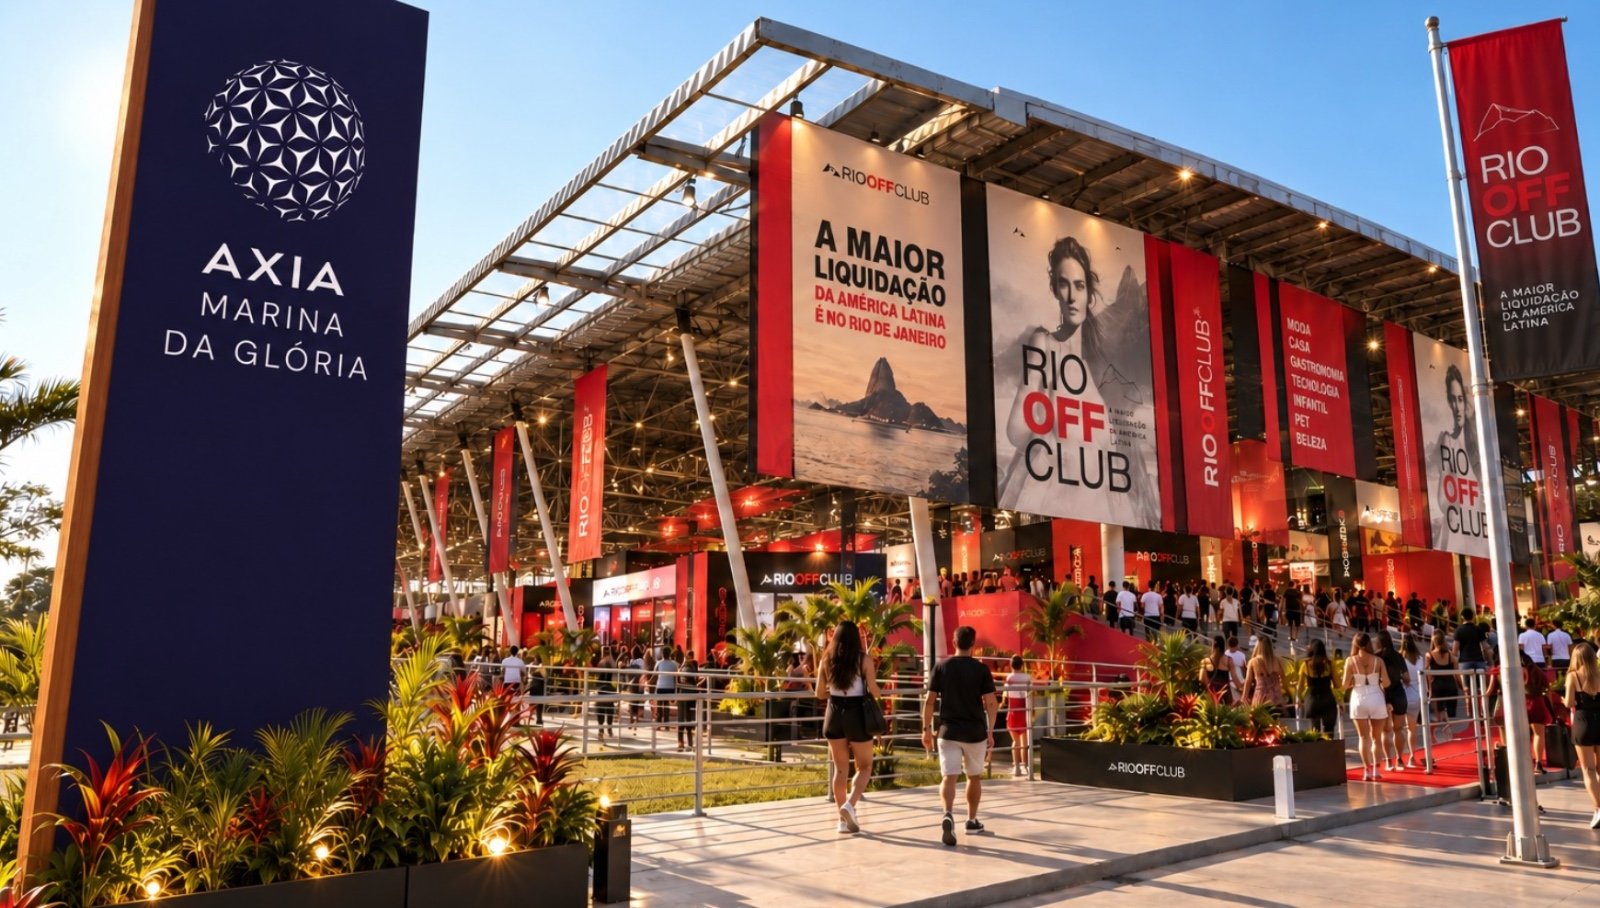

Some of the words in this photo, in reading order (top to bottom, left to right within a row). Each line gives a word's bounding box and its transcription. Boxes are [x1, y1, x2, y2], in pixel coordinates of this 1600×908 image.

[1480, 145, 1549, 184] RIO
[1482, 172, 1570, 217] OFF
[1486, 208, 1582, 248] CLUB
[814, 219, 837, 252] A
[847, 226, 945, 280] MAIOR
[201, 242, 345, 297] AXIA
[815, 254, 947, 307] LIQUIDAÇÃO
[815, 285, 834, 304] DA
[837, 293, 898, 319] AMÉRICA
[901, 307, 946, 330] LATINA
[1500, 290, 1508, 299] A
[1513, 283, 1554, 297] MAIOR
[200, 291, 344, 338] MARINA
[815, 304, 824, 323] É
[826, 309, 846, 328] NO
[849, 315, 872, 333] RIO
[874, 321, 890, 338] DE
[893, 326, 947, 350] JANEIRO
[1287, 318, 1311, 336] MODA
[1502, 310, 1519, 321] DA
[1522, 302, 1575, 318] AMERICA
[1503, 317, 1549, 332] LATINA
[163, 329, 215, 361] DA
[234, 340, 368, 381] GLÓRIA
[1288, 336, 1311, 354] CASA
[1022, 344, 1087, 395] RIO
[1290, 355, 1345, 383] GASTRONOMIA
[1291, 374, 1340, 399] TECNOLOGIA
[1022, 391, 1105, 443] OFF
[1293, 394, 1328, 415] INFANTIL
[1295, 412, 1310, 428] PET
[1296, 432, 1327, 451] BELEZA
[1440, 445, 1469, 476] RIO
[1025, 438, 1132, 493] CLUB
[1443, 474, 1479, 506] OFF
